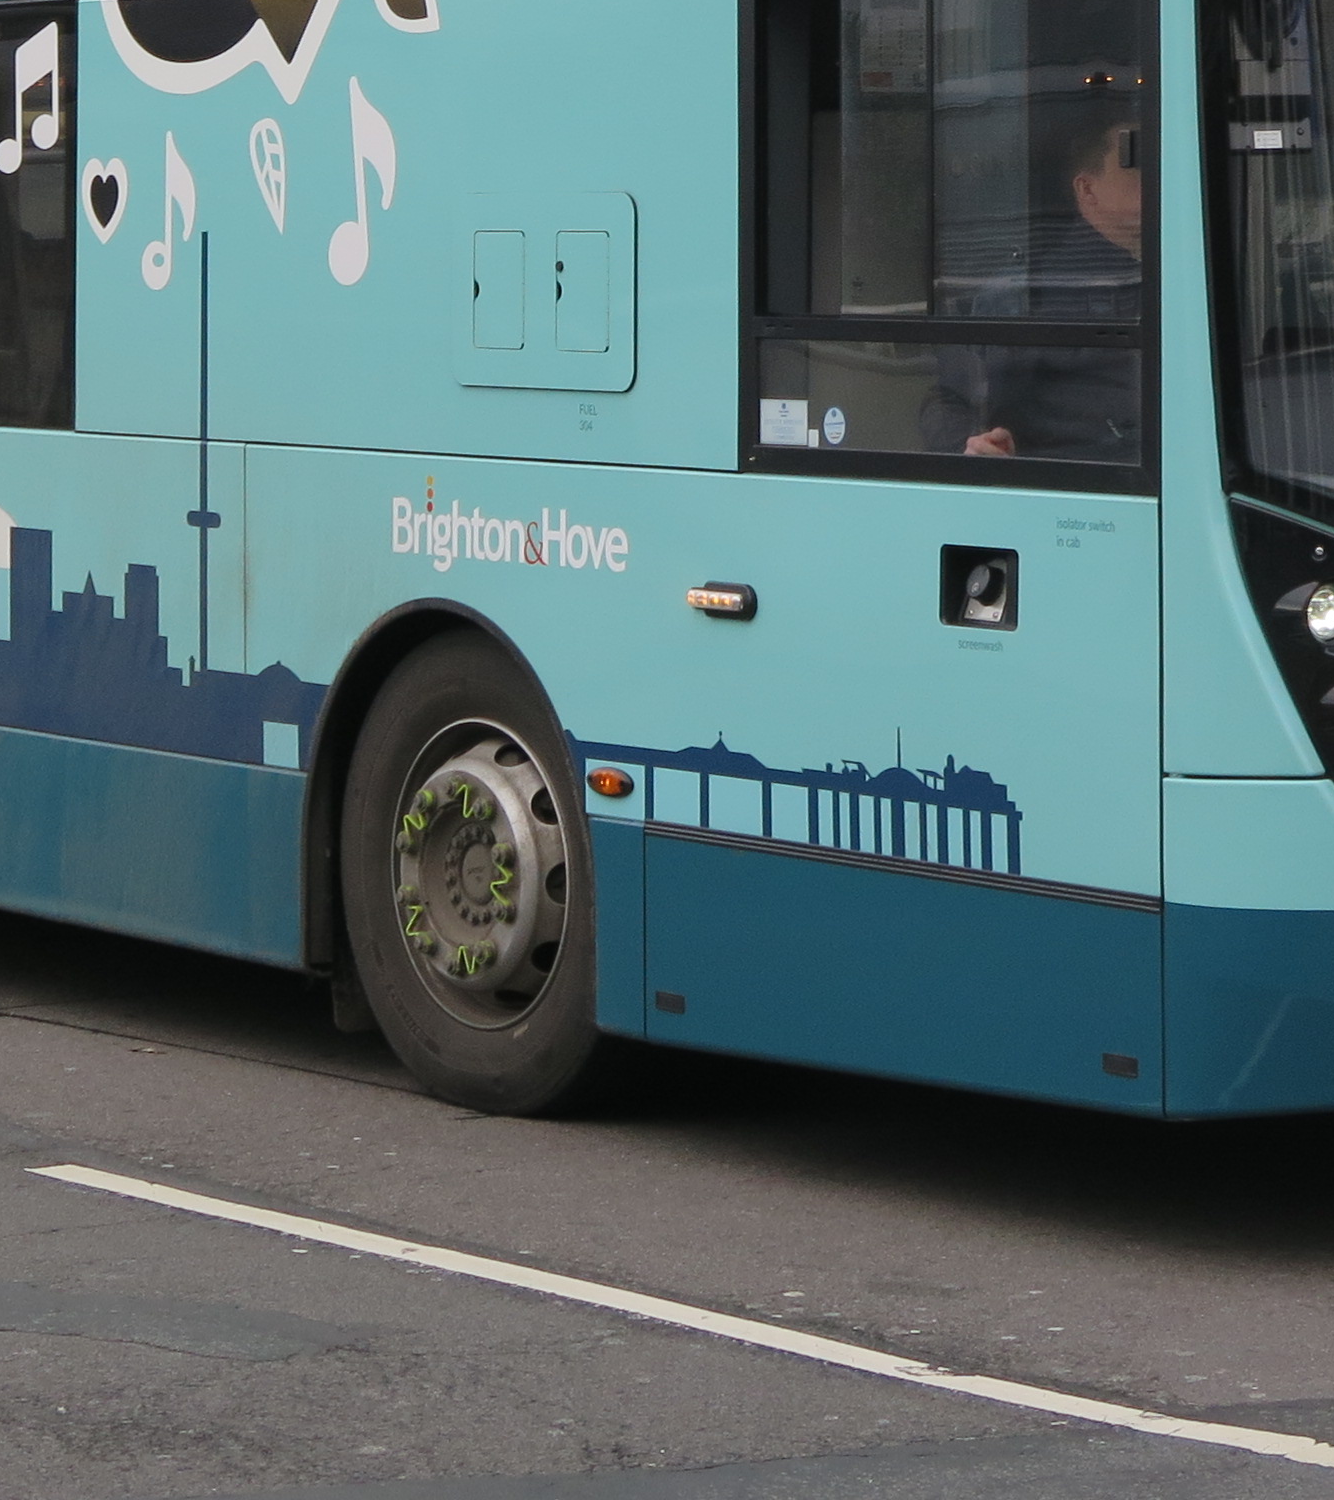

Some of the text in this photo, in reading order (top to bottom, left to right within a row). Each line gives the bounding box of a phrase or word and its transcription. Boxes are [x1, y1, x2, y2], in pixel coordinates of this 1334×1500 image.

[579, 403, 598, 416] FUEL
[1056, 516, 1115, 532] isolator switch
[1056, 535, 1080, 548] in cab
[958, 640, 1004, 652] screenwash
